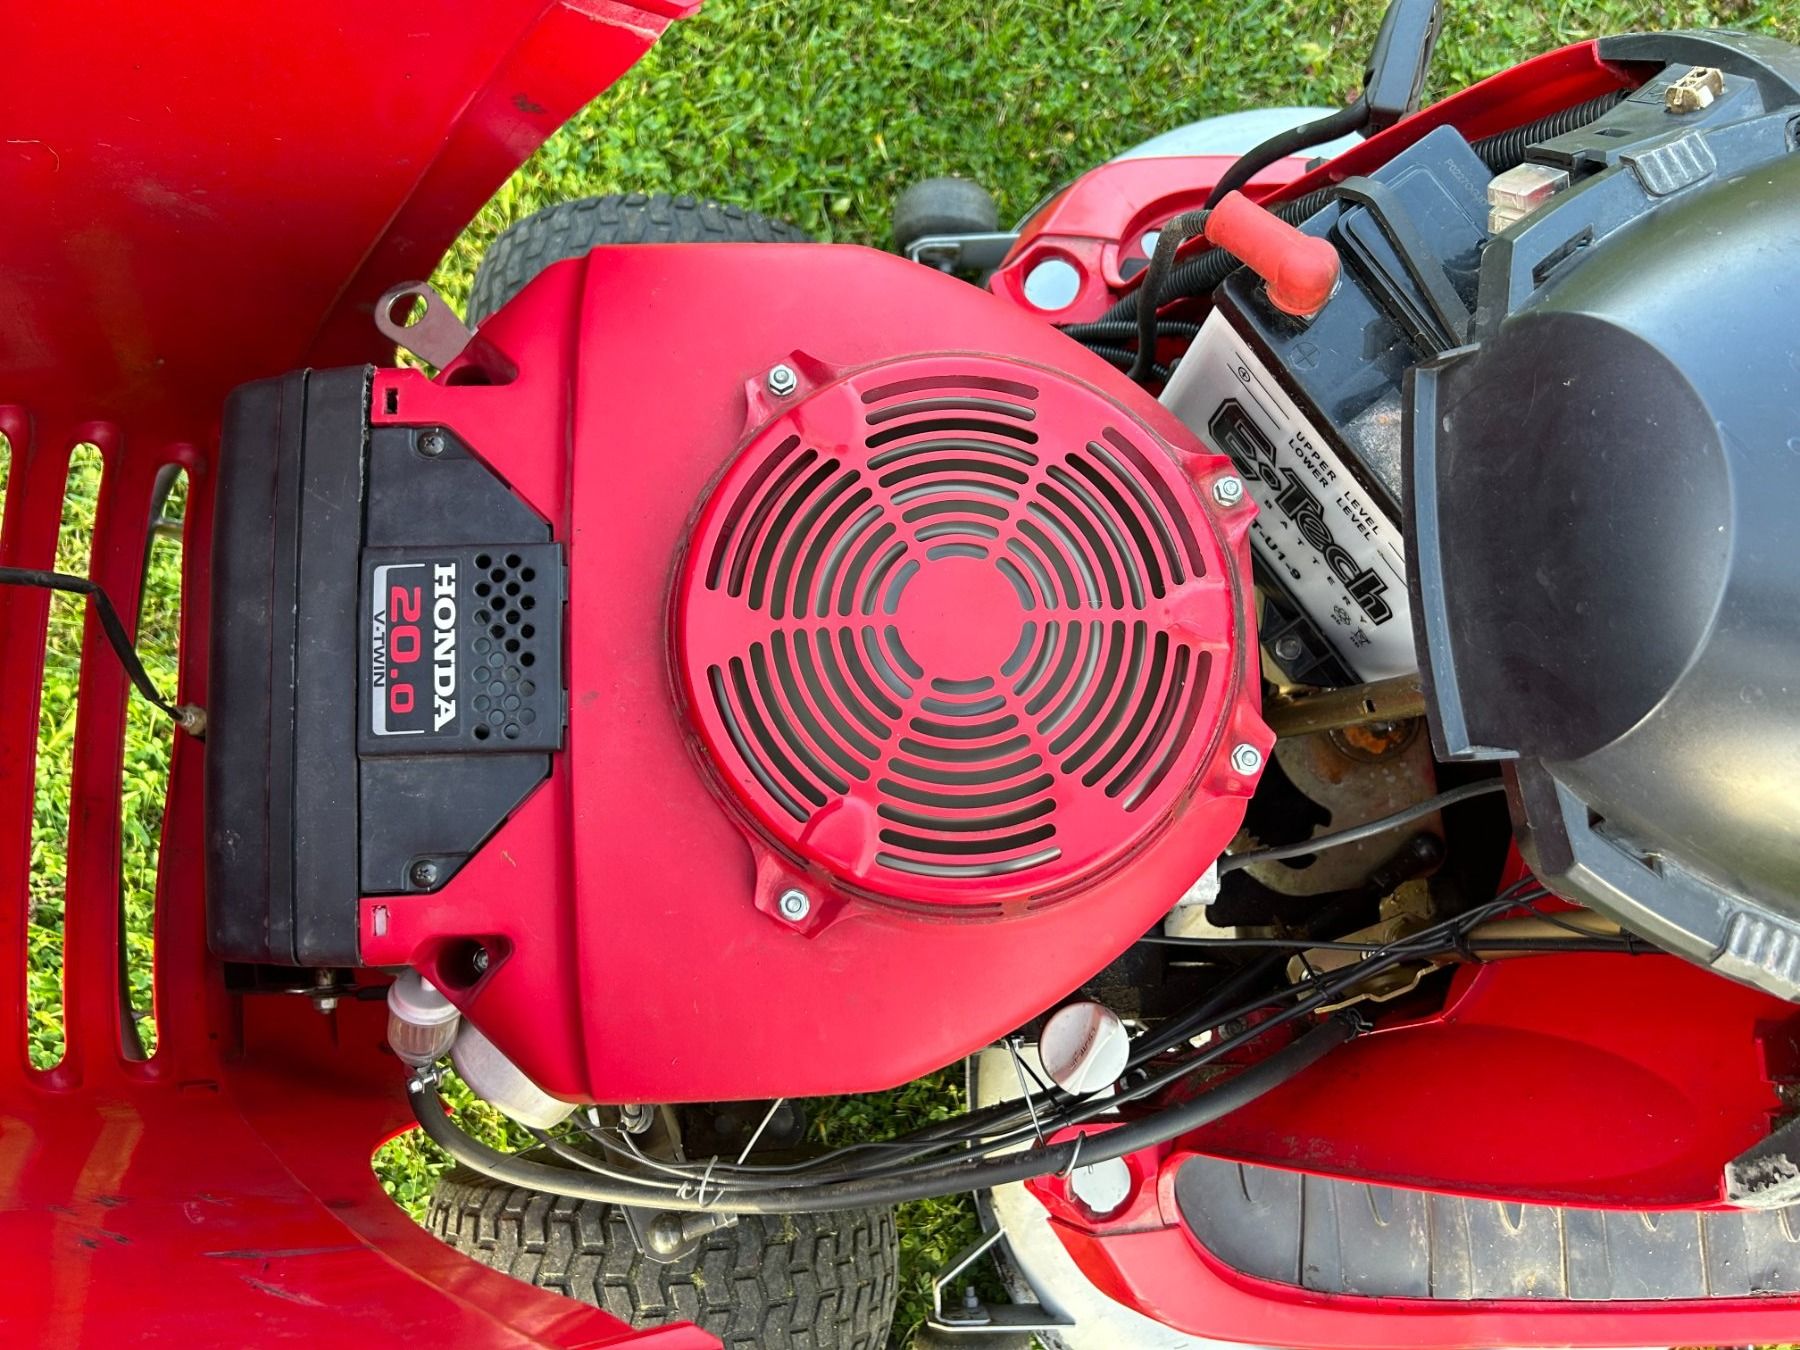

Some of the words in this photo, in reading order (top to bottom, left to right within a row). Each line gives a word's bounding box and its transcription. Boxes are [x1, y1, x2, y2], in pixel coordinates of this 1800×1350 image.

[1288, 438, 1329, 488] LOWER
[1336, 497, 1374, 542] LEVEL
[1296, 431, 1337, 482] UPPER
[1344, 491, 1382, 535] LEVEL
[373, 610, 385, 688] V-TWIN
[390, 586, 421, 713] 20.0
[433, 563, 456, 732] HONDA
